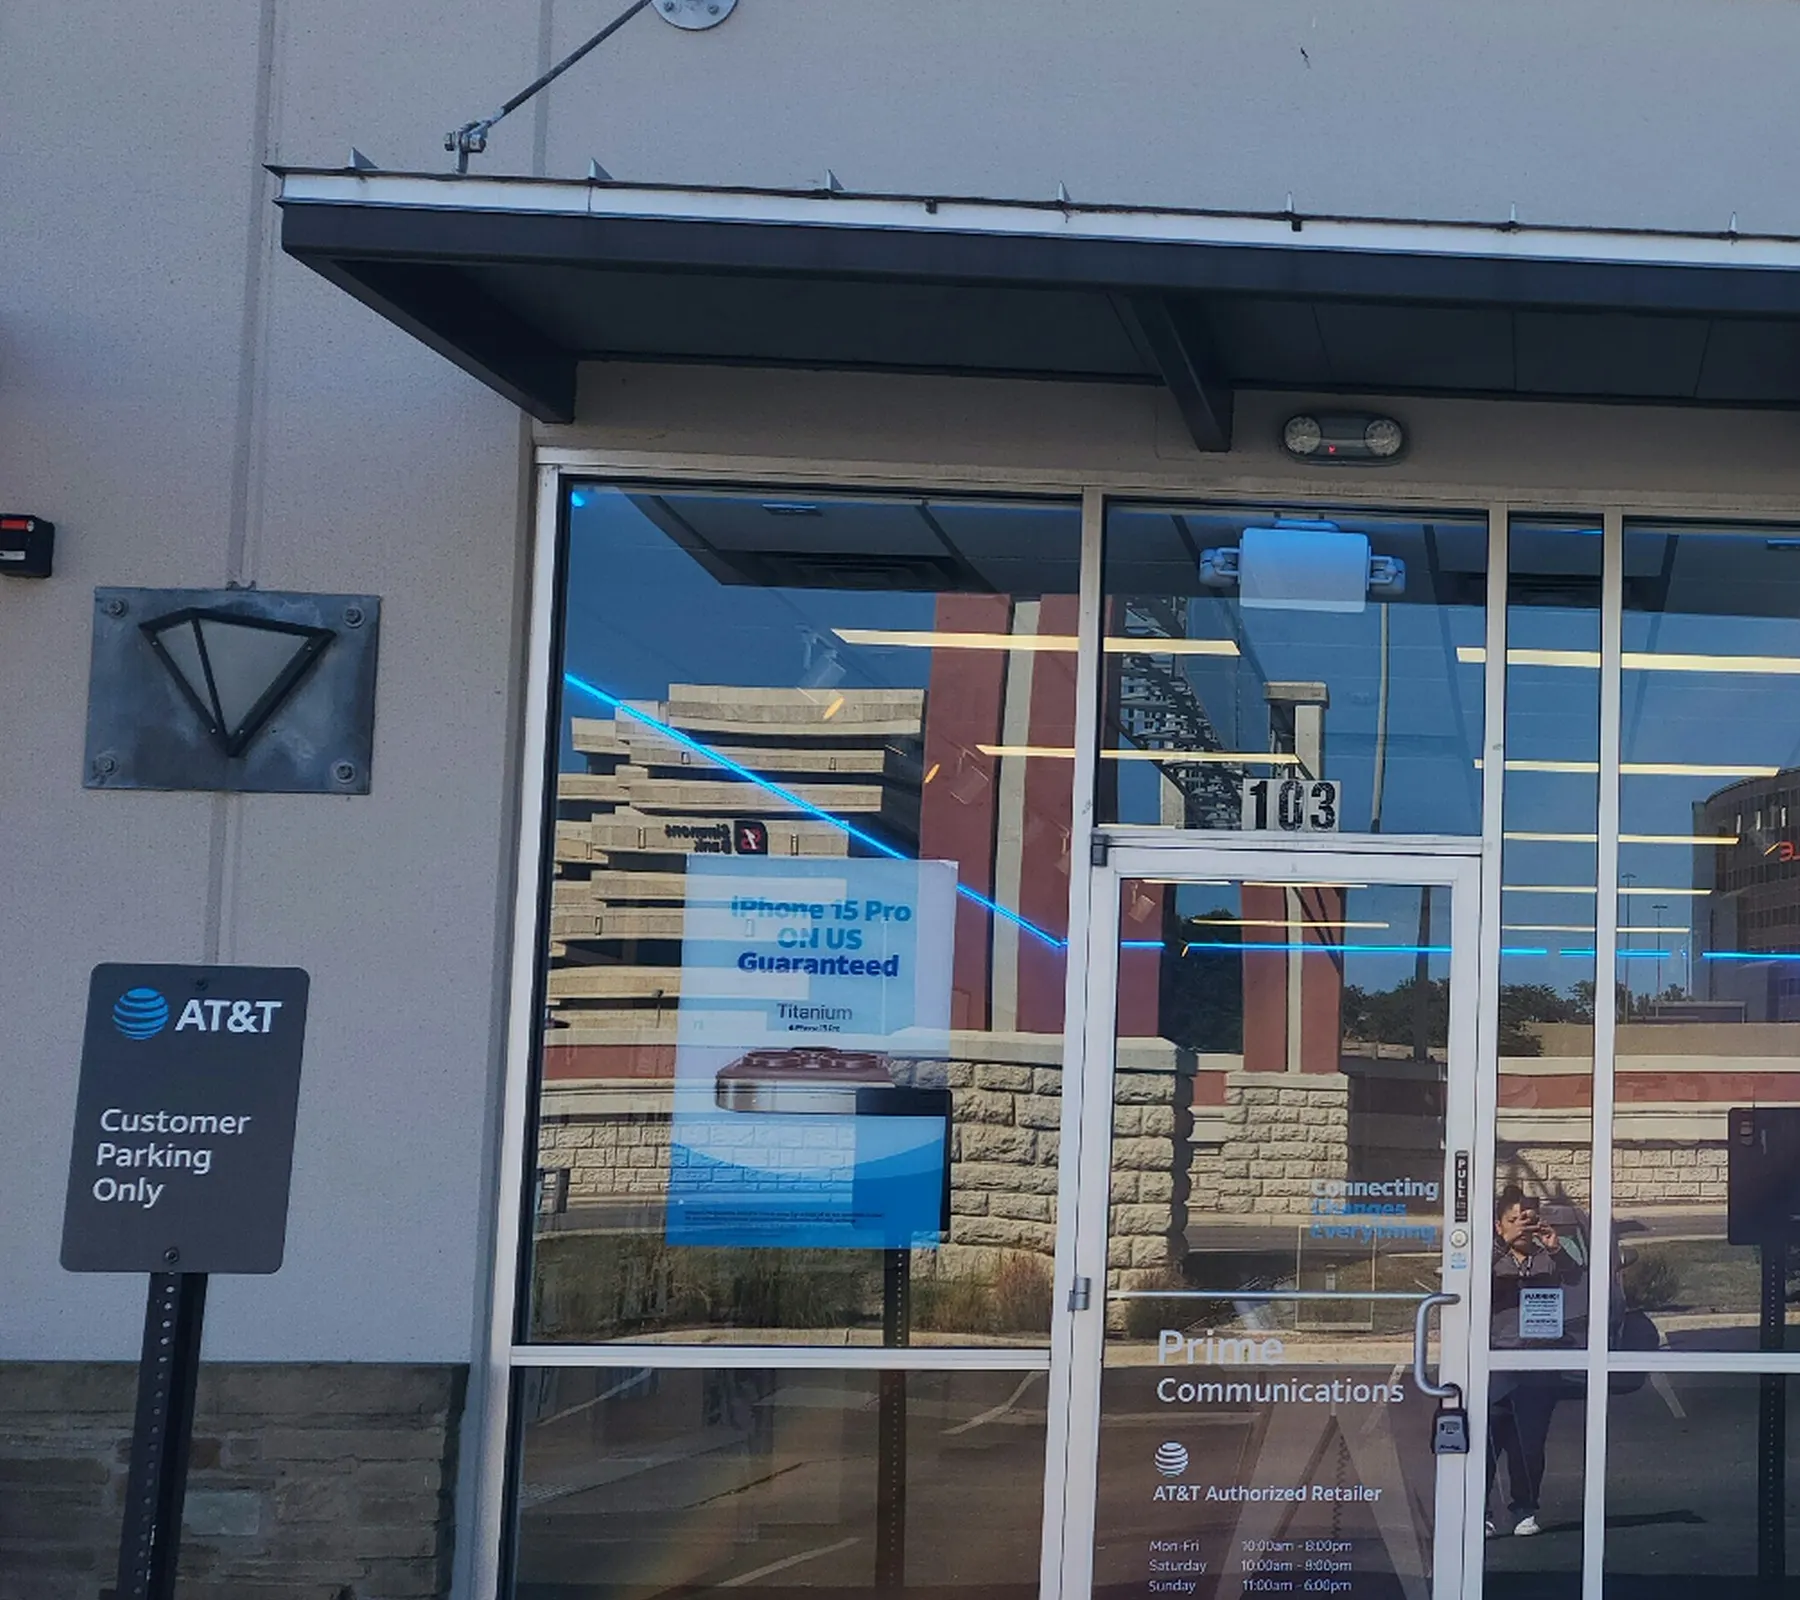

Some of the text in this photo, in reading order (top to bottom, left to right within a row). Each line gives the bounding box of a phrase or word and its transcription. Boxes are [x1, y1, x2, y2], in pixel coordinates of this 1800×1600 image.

[1249, 780, 1336, 831] 103
[731, 895, 912, 922] iPhone 15 Pro
[777, 927, 863, 950] ON US
[738, 951, 900, 977] Guaranteed
[175, 999, 283, 1034] AT&T
[777, 1003, 853, 1021] Titanium
[100, 1108, 251, 1135] Customer
[96, 1142, 212, 1175] Parking
[92, 1177, 165, 1209] Only
[1311, 1177, 1440, 1202] Connecting
[1157, 1329, 1285, 1365] Prime
[1156, 1377, 1405, 1403] Communications
[1153, 1485, 1383, 1501] AT&T Authorized Retailer
[1149, 1539, 1200, 1552] Mon-Fri
[1149, 1558, 1208, 1573] Saturday
[1149, 1579, 1197, 1594] Sunday
